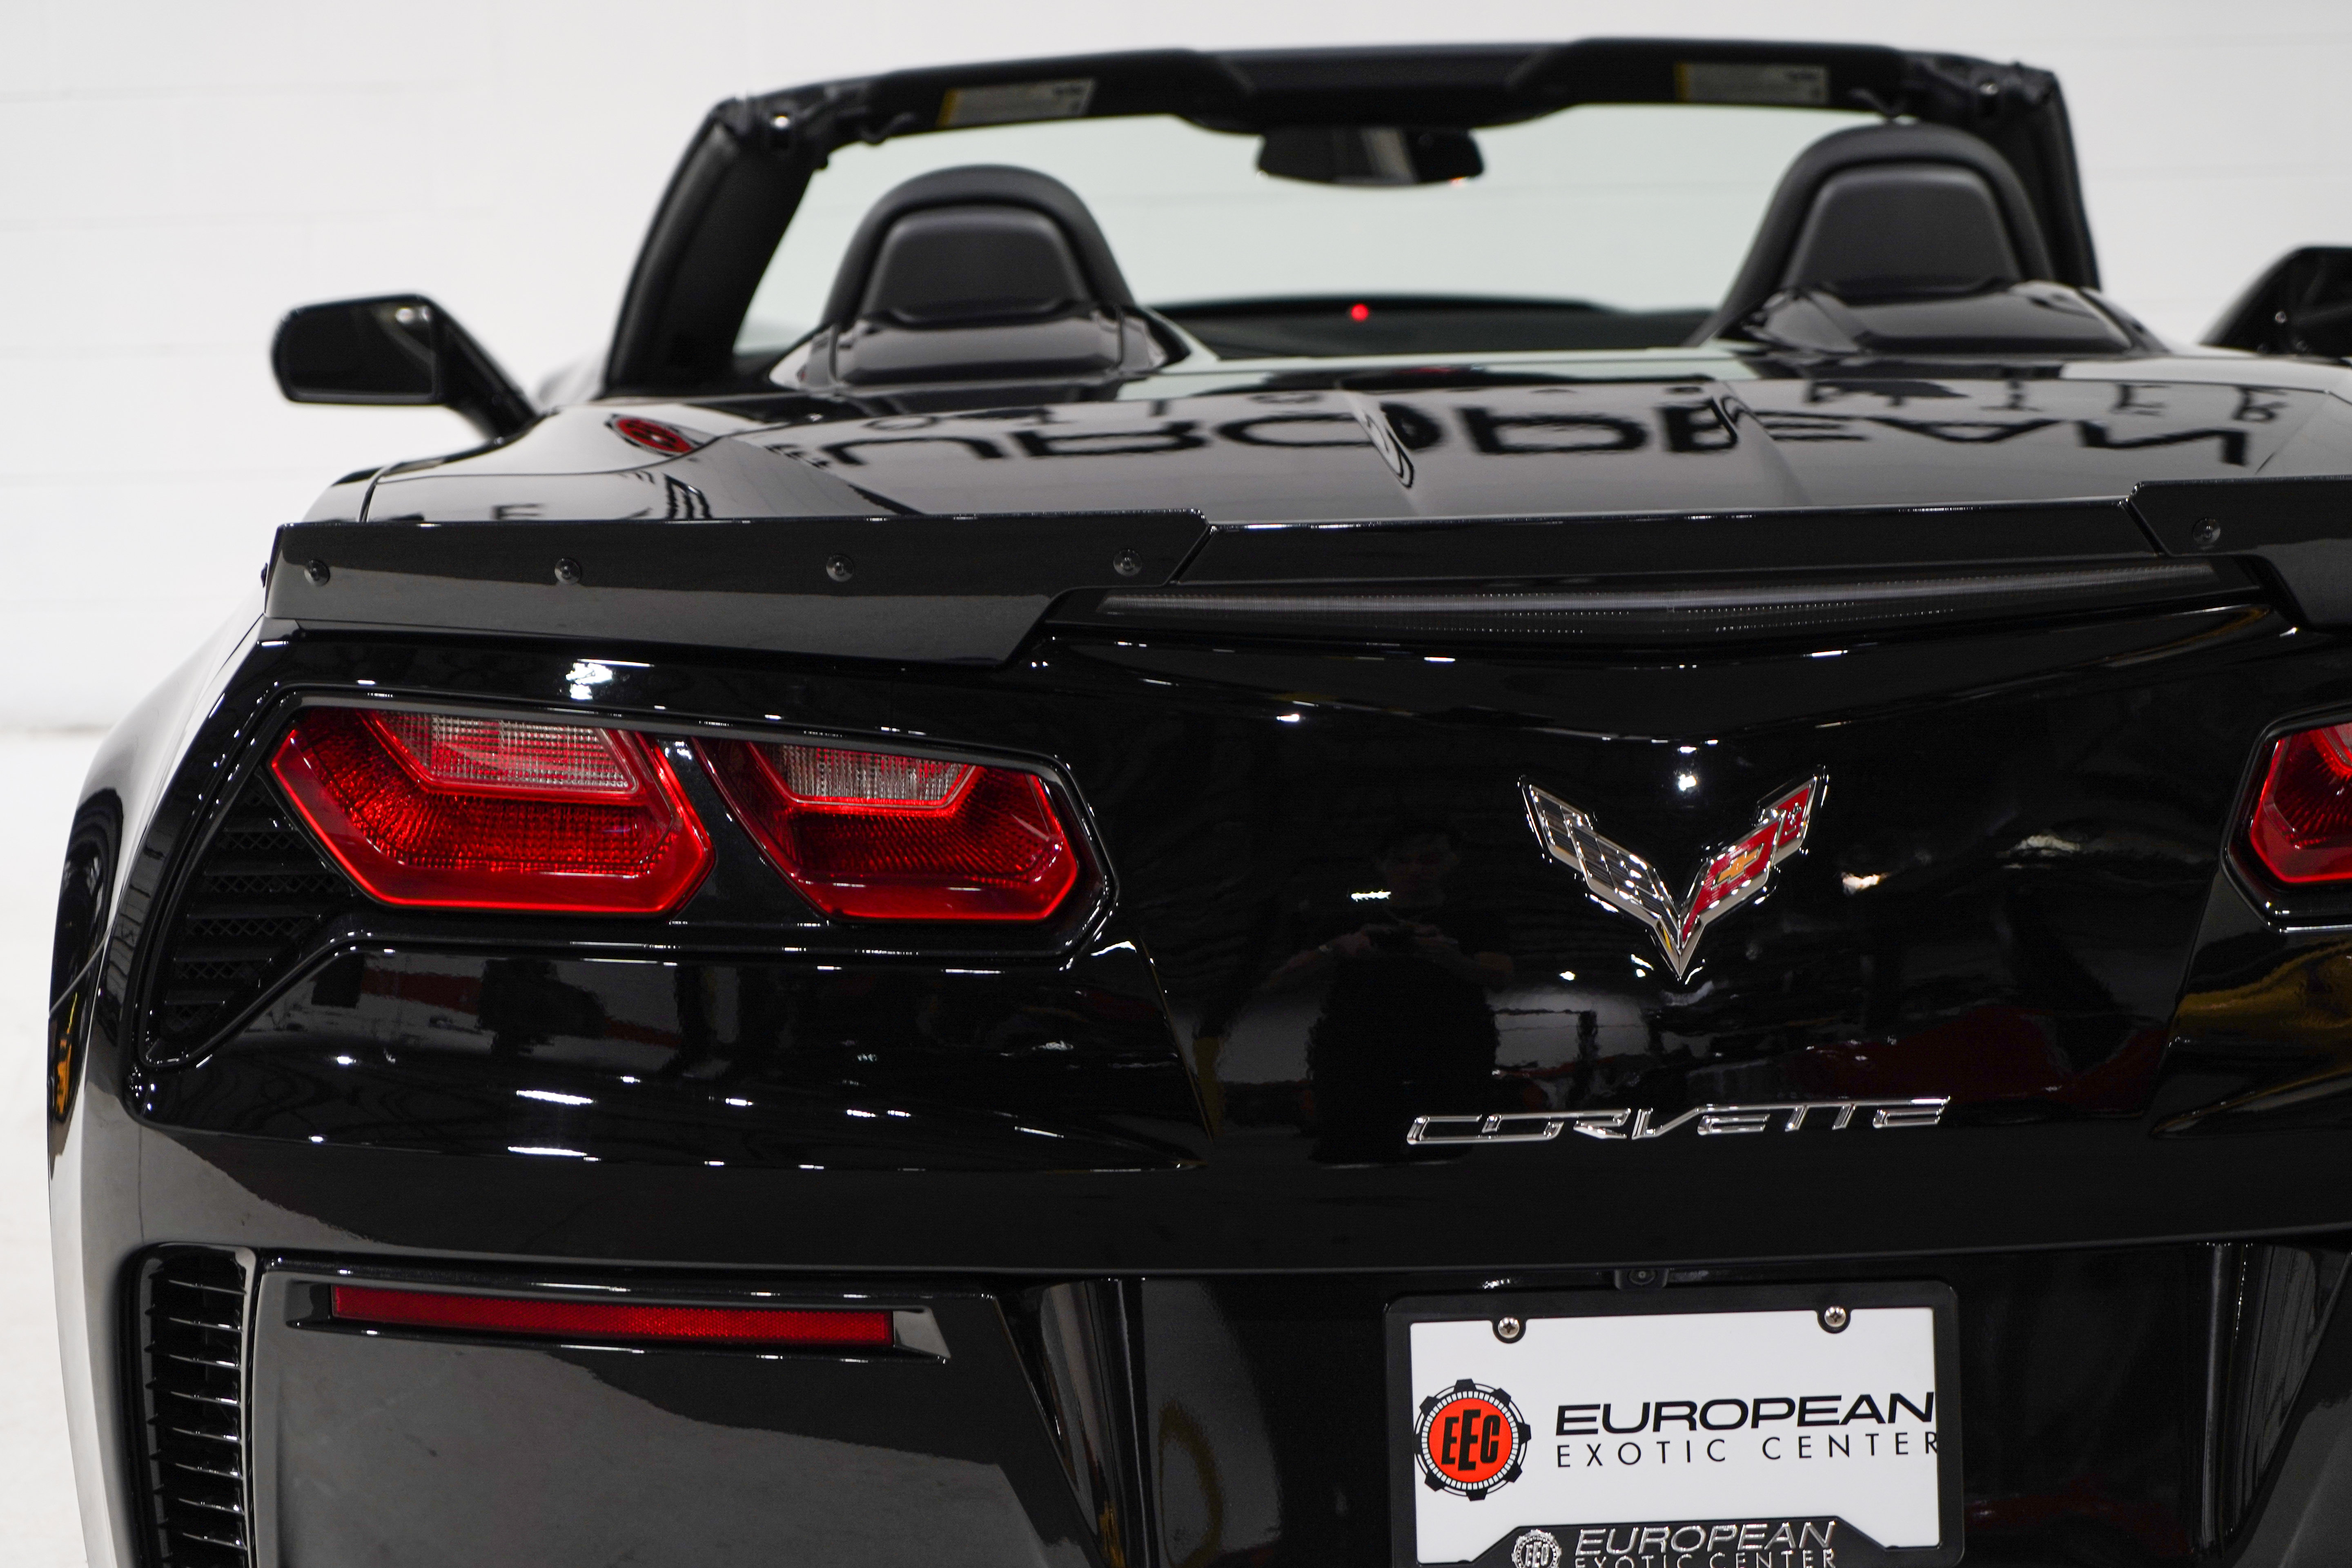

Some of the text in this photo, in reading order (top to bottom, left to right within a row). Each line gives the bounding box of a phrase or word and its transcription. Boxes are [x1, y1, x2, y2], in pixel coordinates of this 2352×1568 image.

[1406, 1096, 1951, 1145] CORVETTE
[1555, 1391, 1934, 1436] EUROPEAN
[1441, 1409, 1501, 1471] EEC
[1557, 1431, 1938, 1468] EXOTIC CENTER
[1575, 1520, 1836, 1556] EUROPEAN
[1709, 1548, 1836, 1568] CENTER
